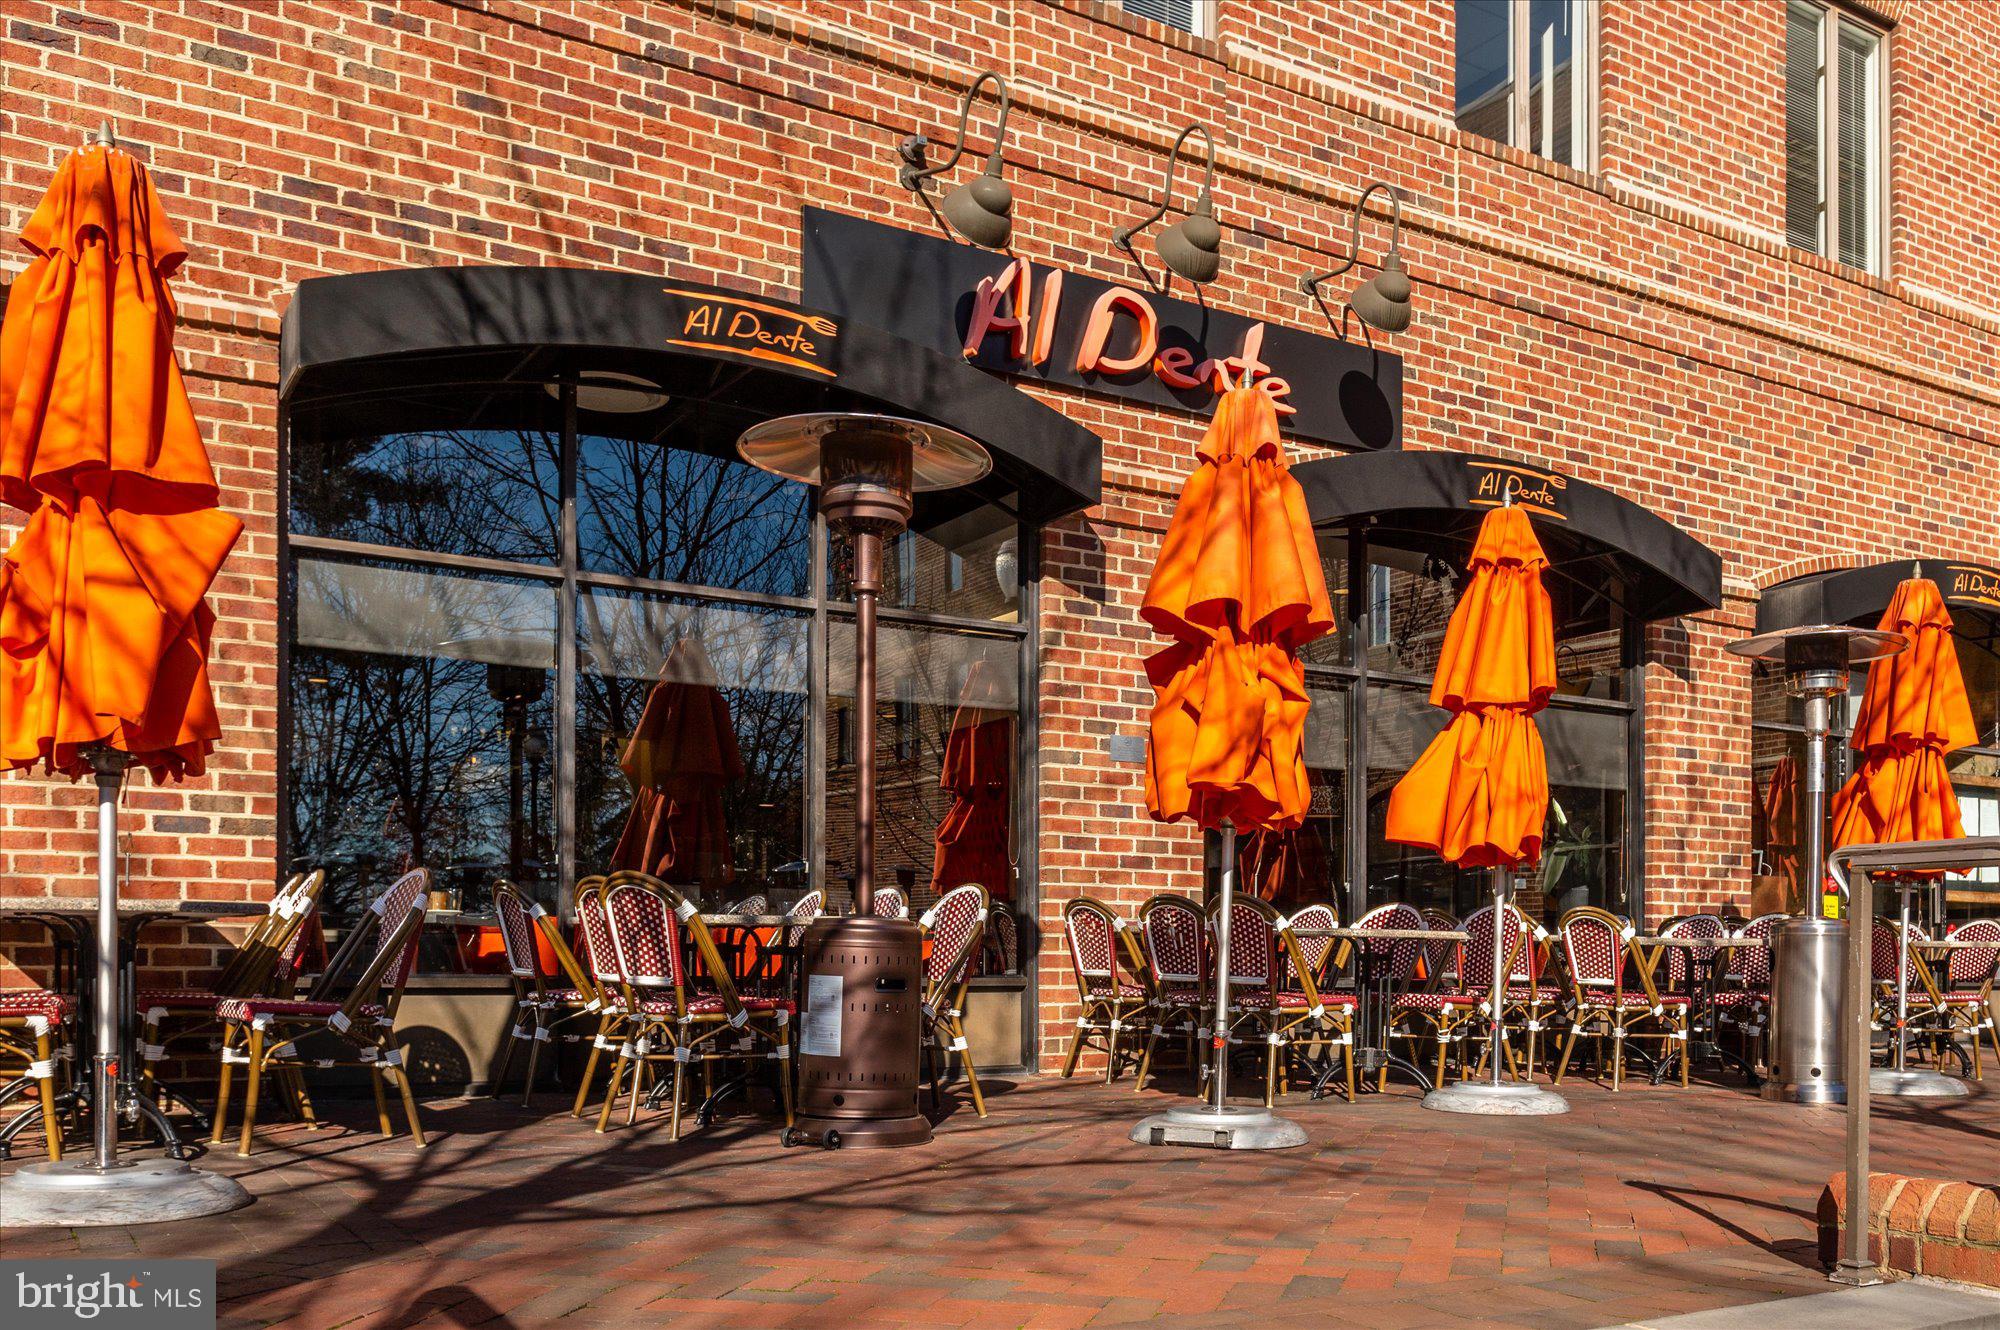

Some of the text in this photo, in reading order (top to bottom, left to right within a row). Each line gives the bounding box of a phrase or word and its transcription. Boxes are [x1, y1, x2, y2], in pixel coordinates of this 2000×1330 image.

[684, 305, 817, 356] Al Dente
[963, 256, 1297, 415] Al Dente
[1478, 471, 1555, 505] Al Dente
[1954, 573, 1969, 592] Al
